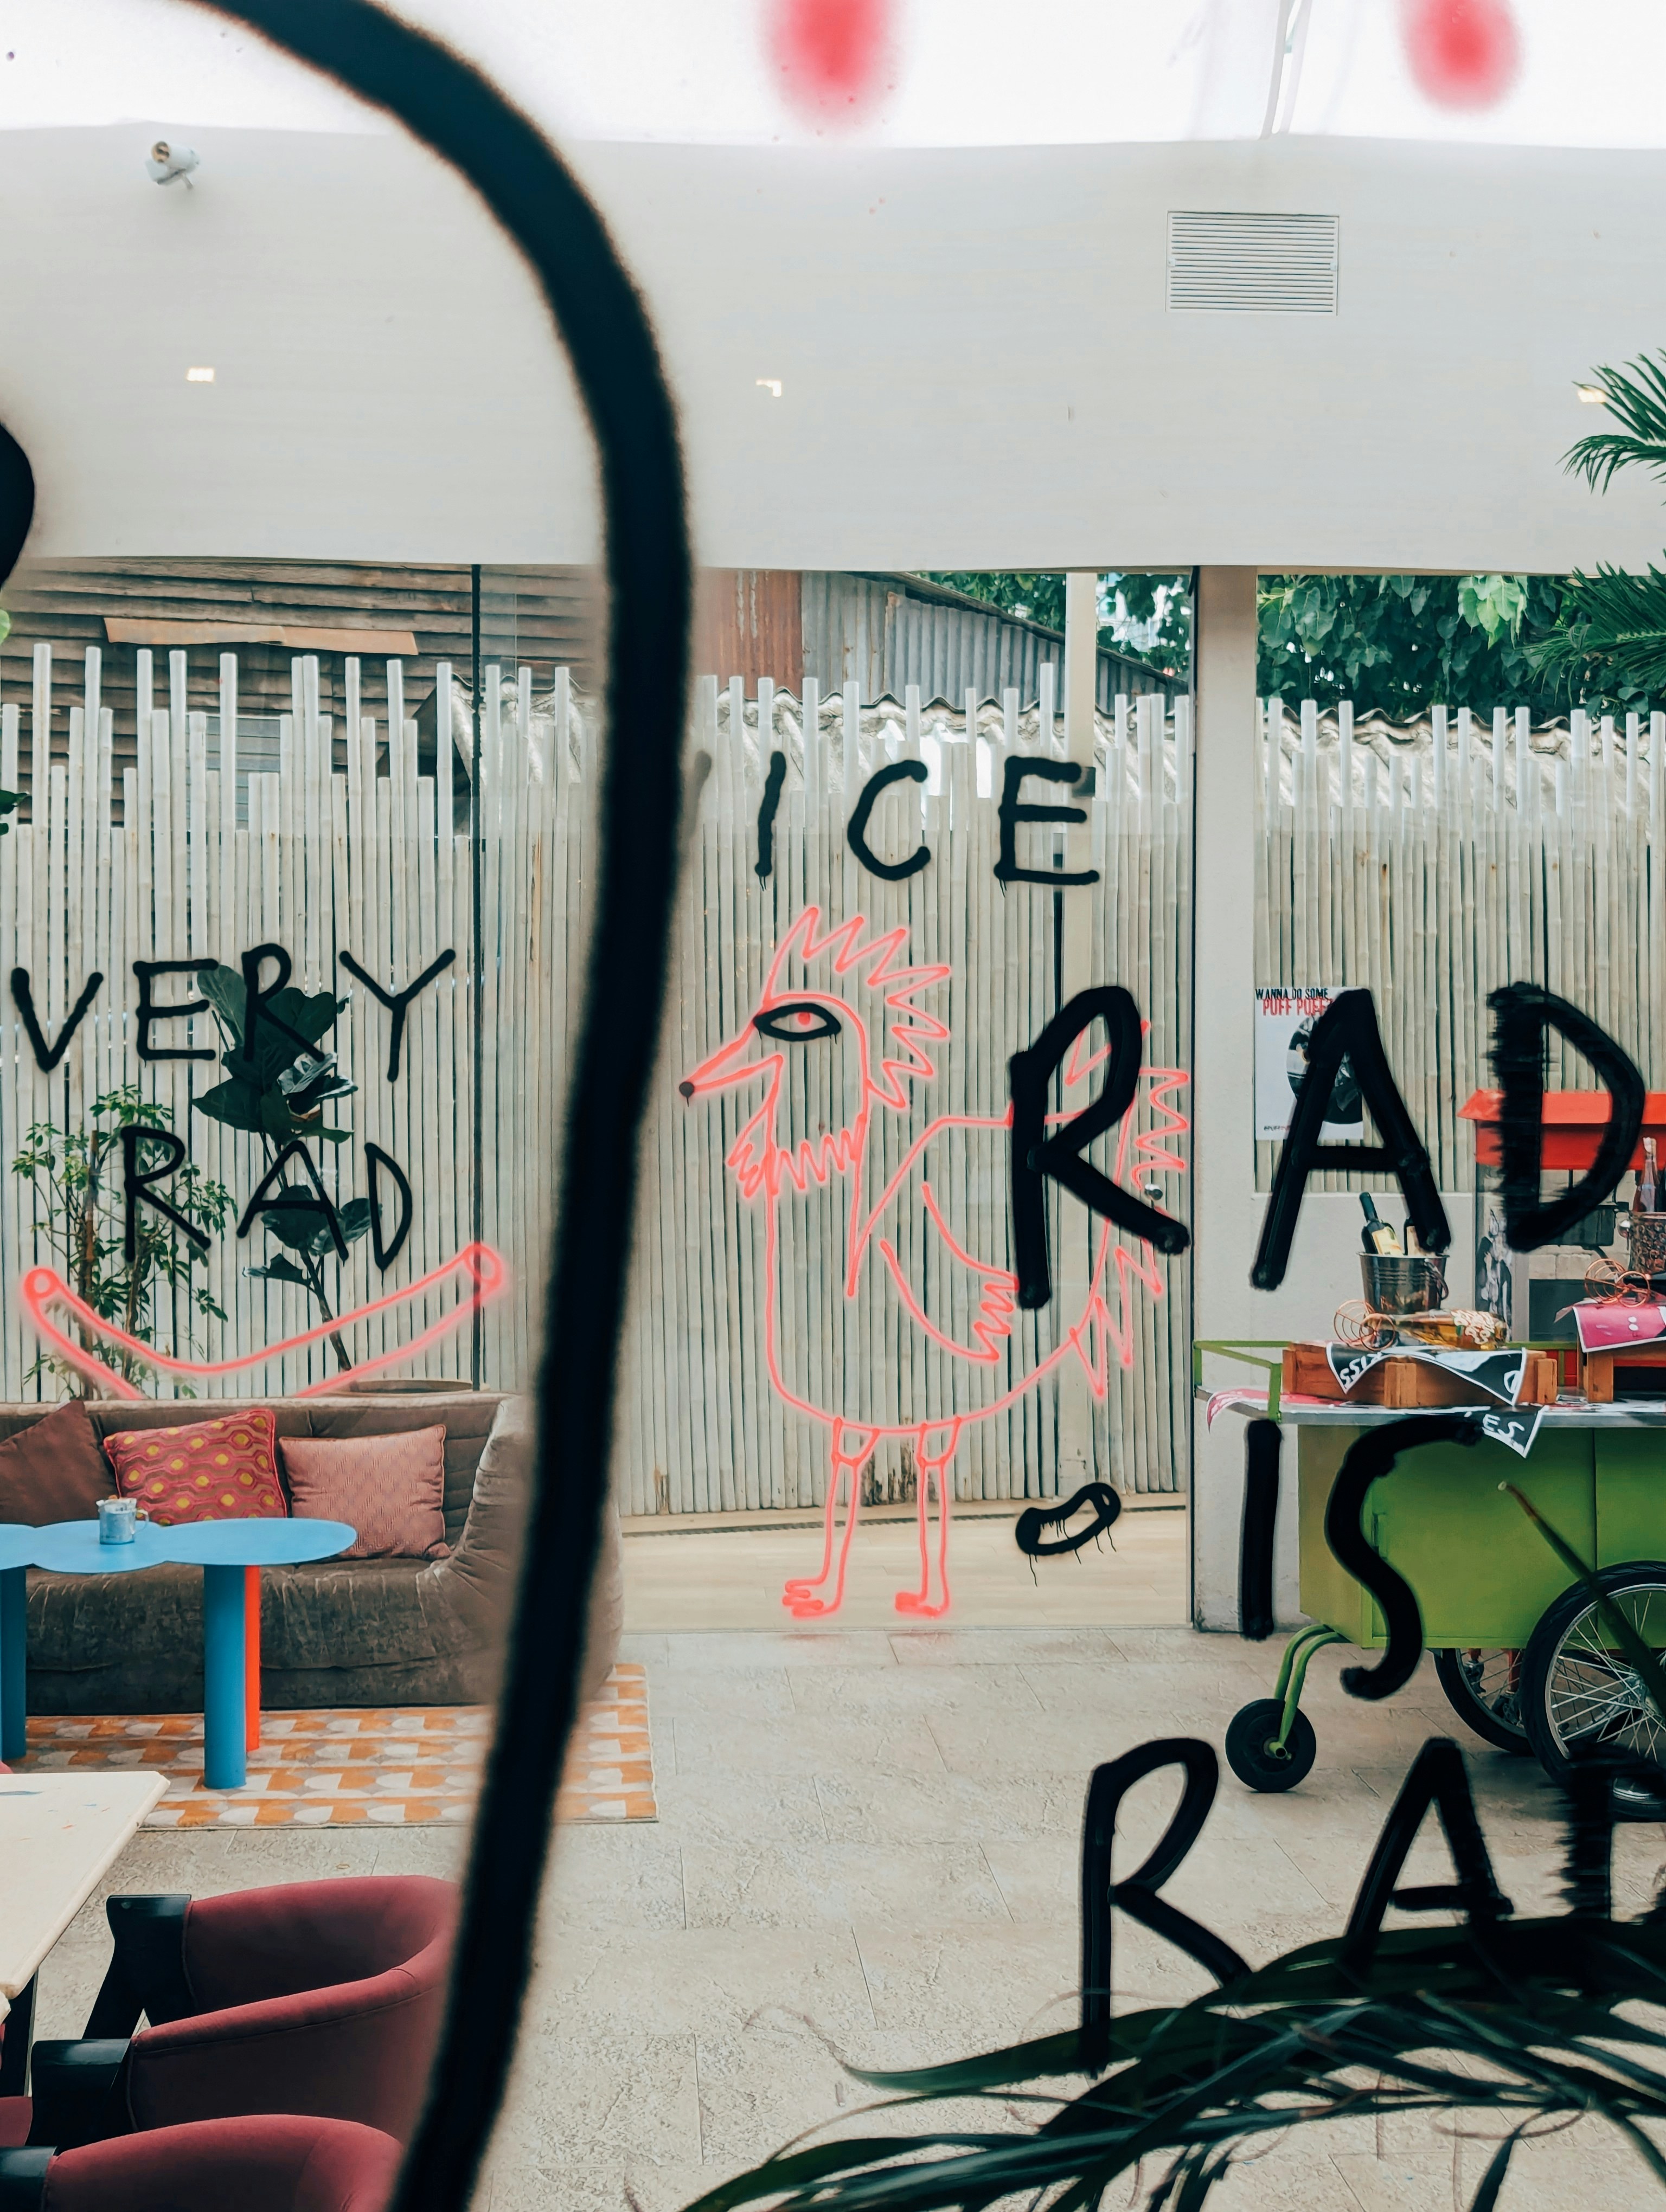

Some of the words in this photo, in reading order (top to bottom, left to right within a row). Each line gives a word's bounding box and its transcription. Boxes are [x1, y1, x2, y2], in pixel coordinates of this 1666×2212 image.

[11, 943, 456, 1083] VERY
[1255, 988, 1289, 1000] WANNA
[1292, 988, 1302, 1000] DO
[1305, 988, 1328, 1000] SOME
[1263, 998, 1292, 1016] PUFF
[120, 1124, 414, 1271] RAD
[1010, 982, 1646, 1309] RAD
[1237, 1414, 1483, 1701] IS
